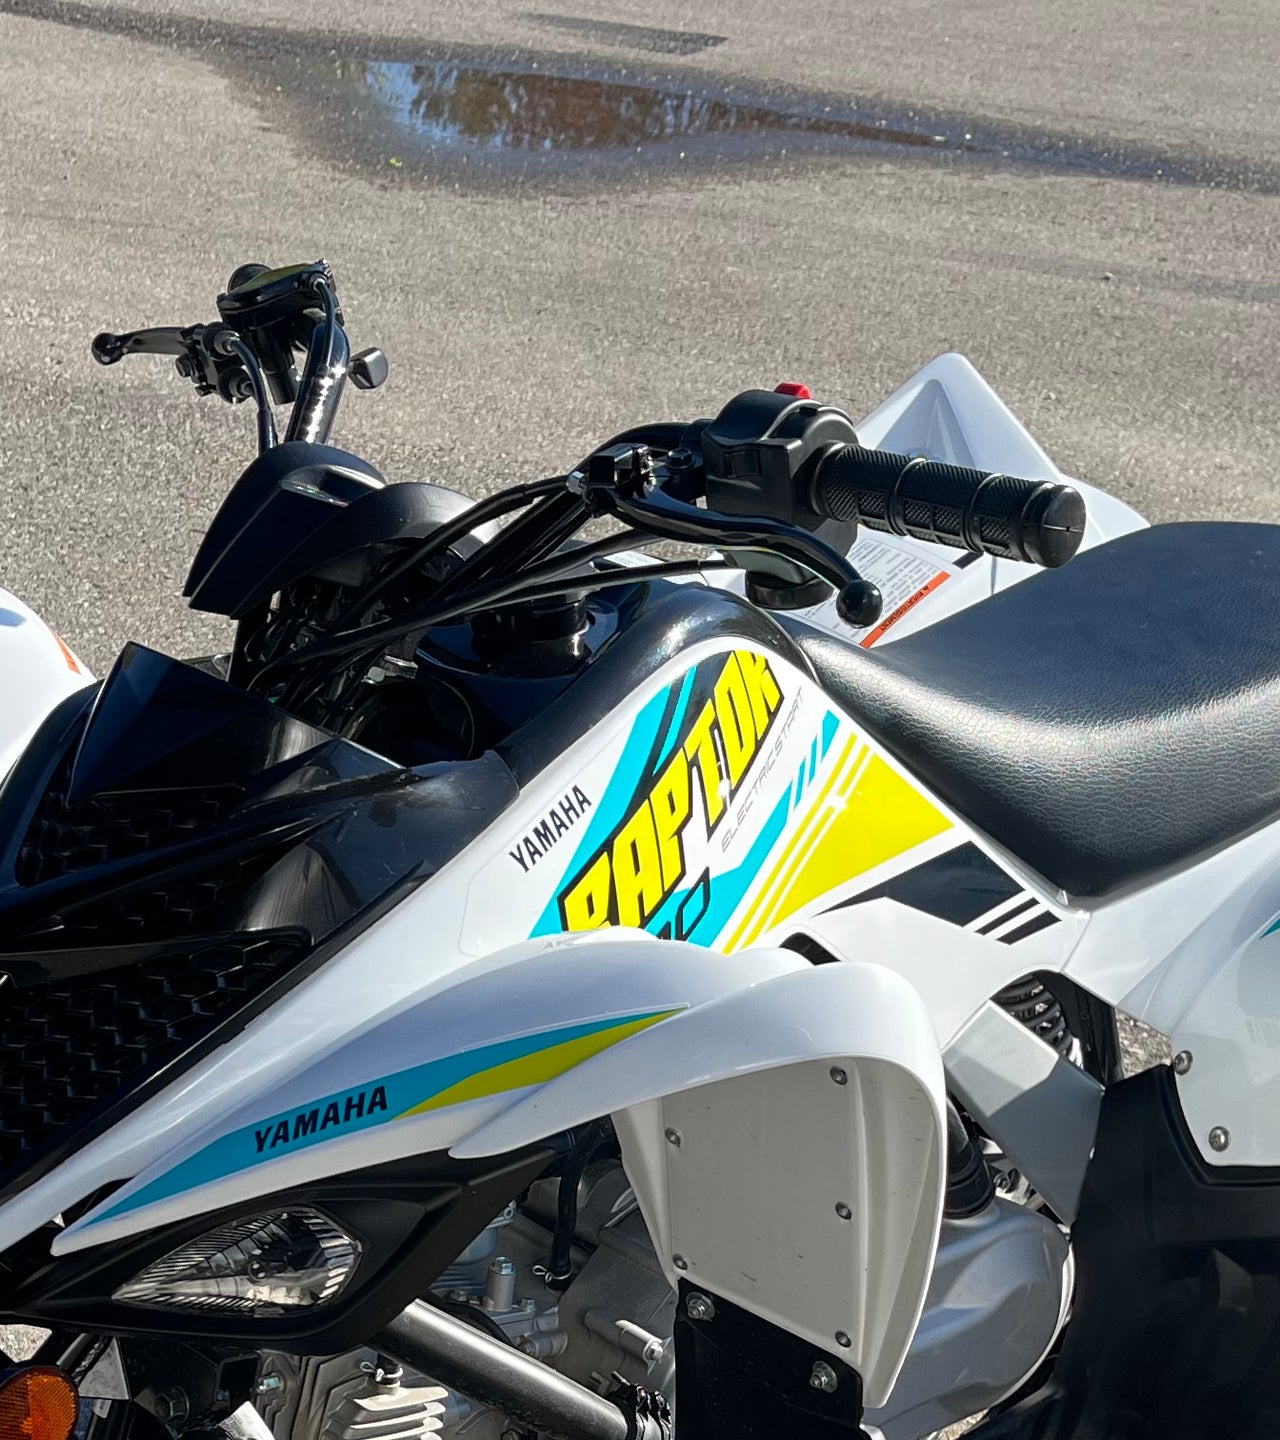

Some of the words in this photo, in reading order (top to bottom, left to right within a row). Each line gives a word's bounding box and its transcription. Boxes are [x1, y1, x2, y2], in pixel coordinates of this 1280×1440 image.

[509, 785, 593, 873] YAMAHA
[558, 649, 785, 934] RAPTOR
[721, 748, 777, 854] ELECTRIC
[772, 685, 804, 756] START
[253, 1084, 388, 1155] YAMAHA
